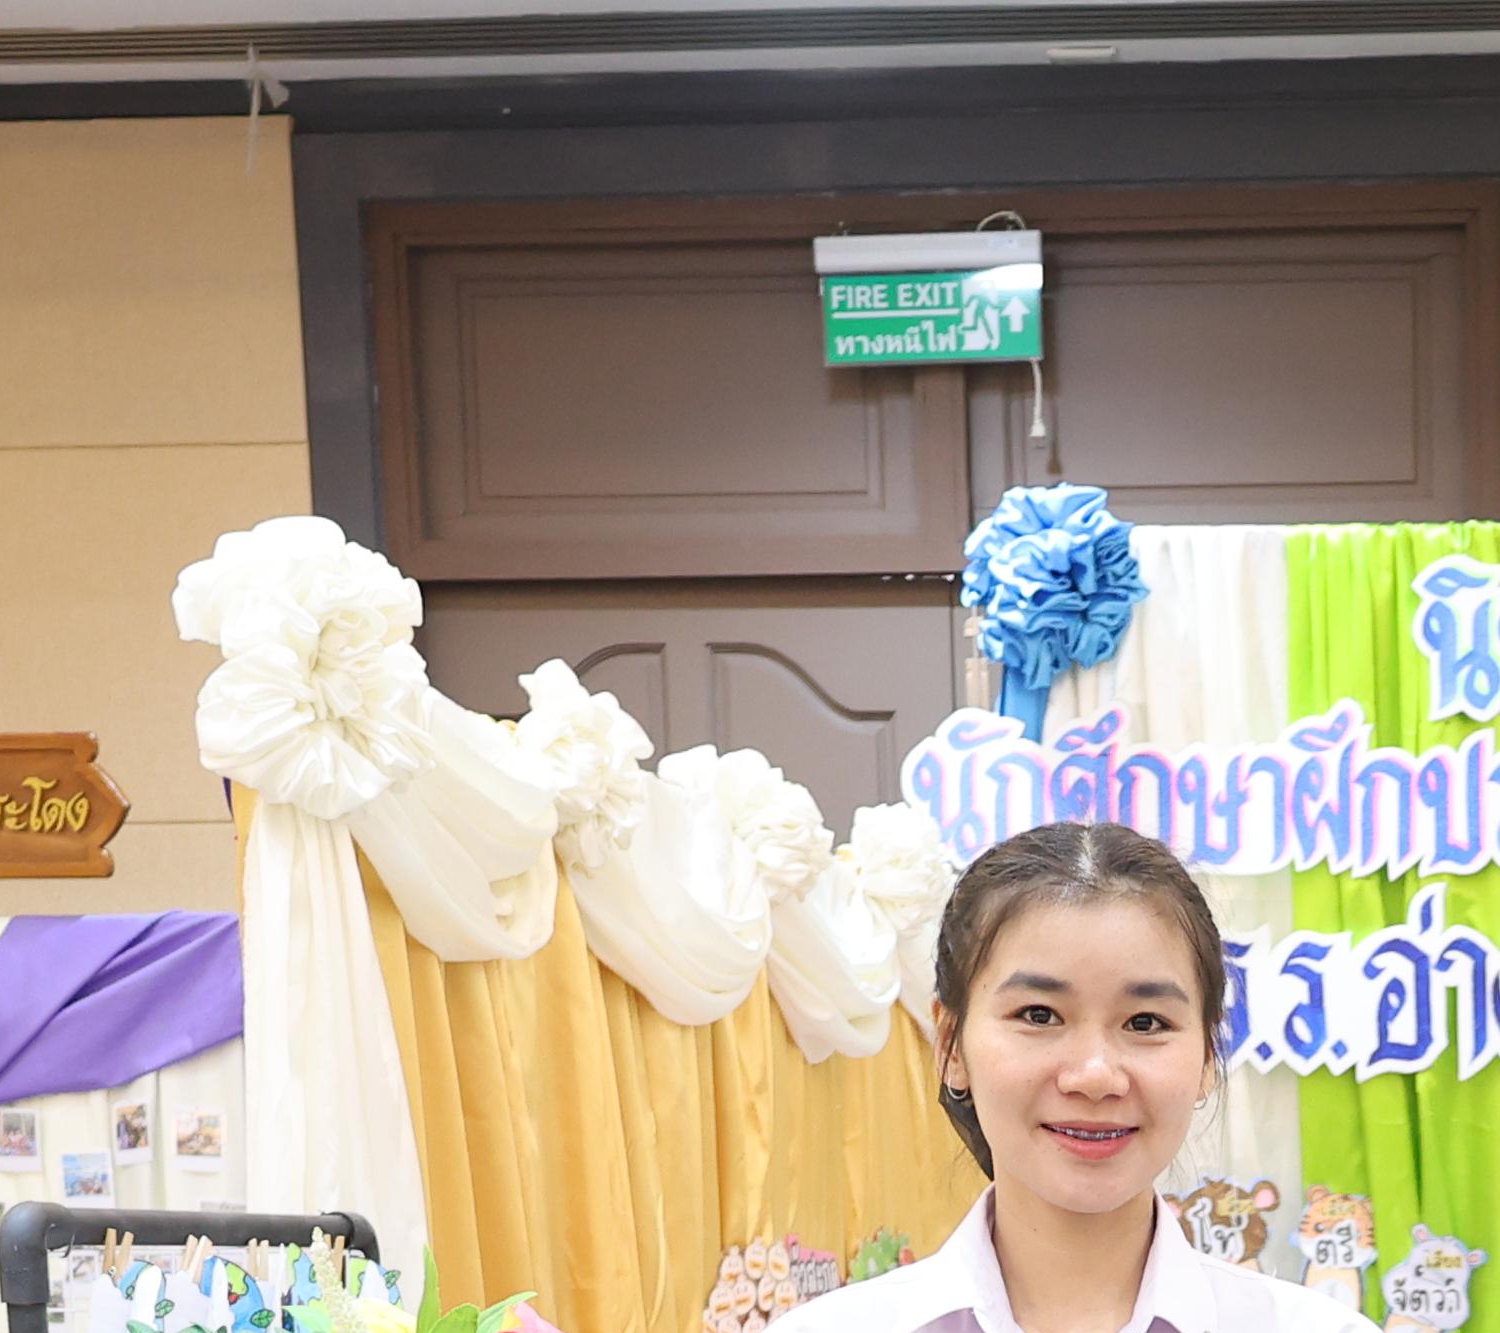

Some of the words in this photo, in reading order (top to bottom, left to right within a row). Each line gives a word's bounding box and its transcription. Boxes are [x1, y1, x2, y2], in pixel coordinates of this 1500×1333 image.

[831, 284, 889, 310] FIRE
[897, 281, 959, 308] EXIT
[834, 319, 958, 357] ทางหนีไฟ
